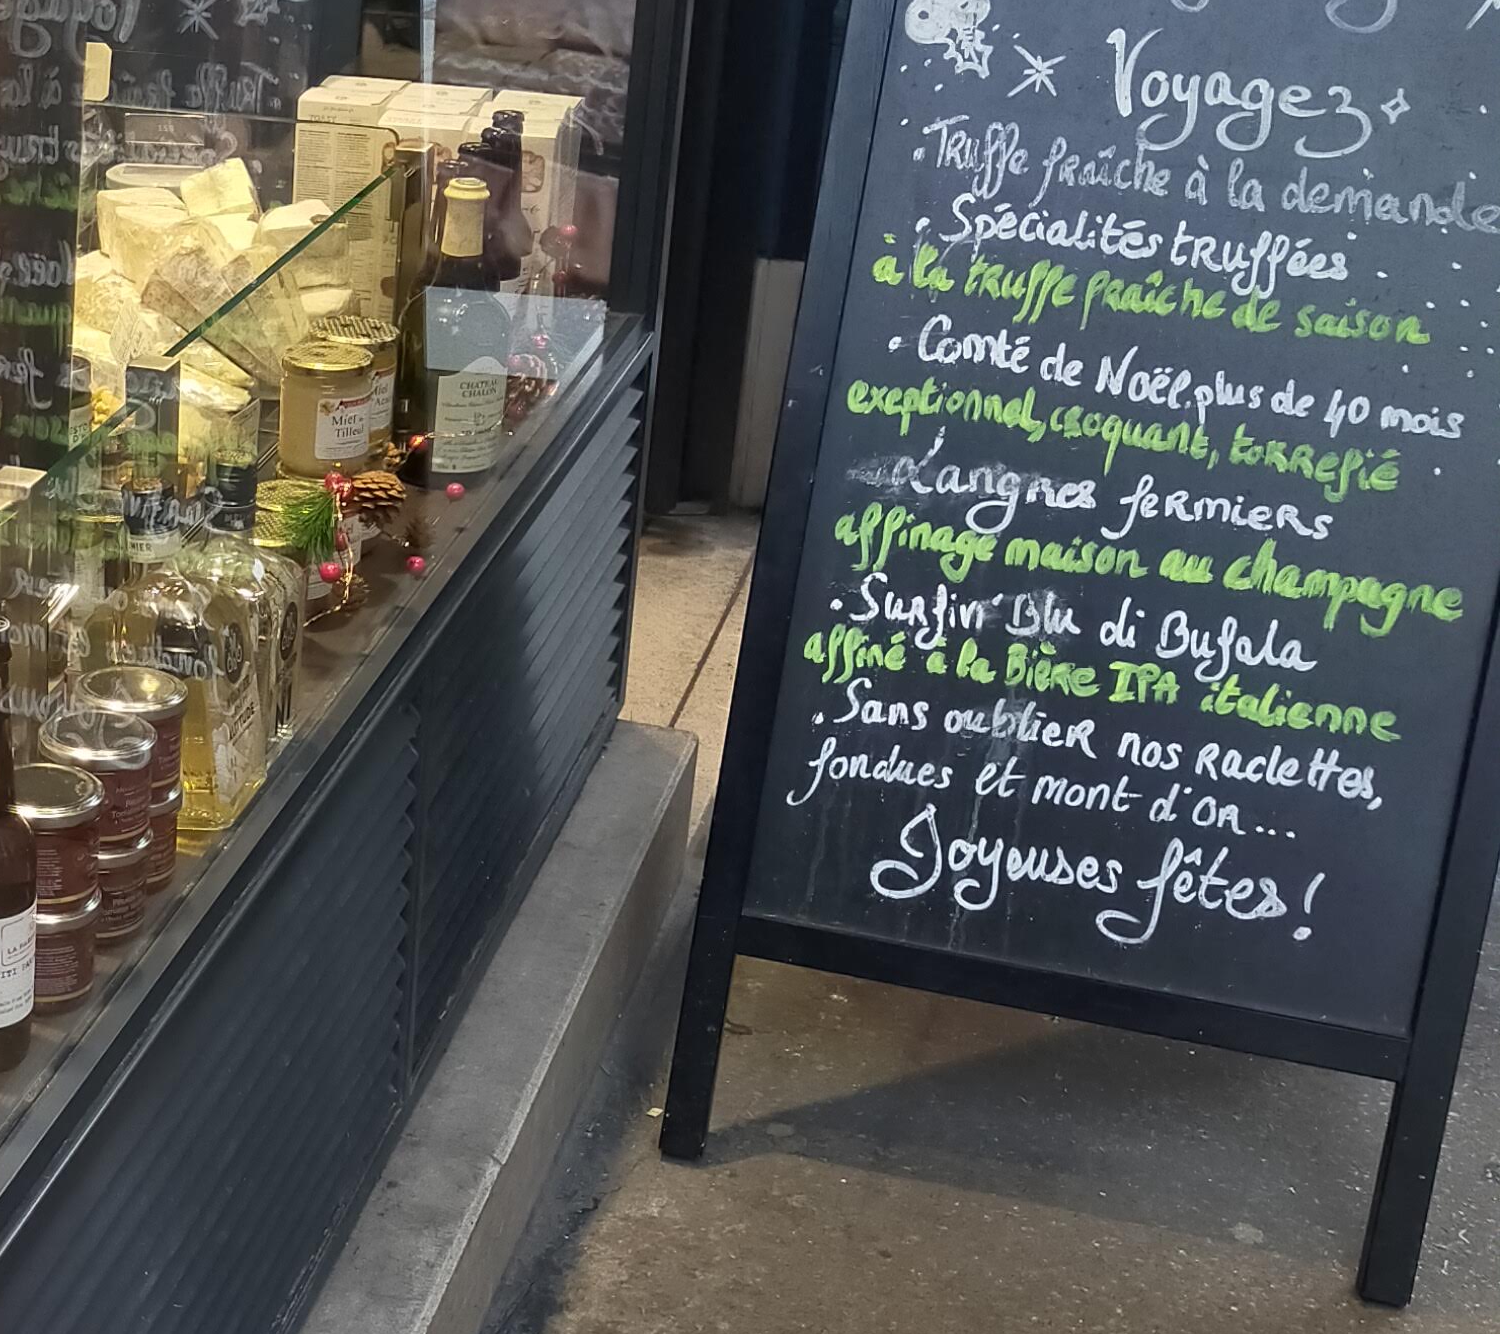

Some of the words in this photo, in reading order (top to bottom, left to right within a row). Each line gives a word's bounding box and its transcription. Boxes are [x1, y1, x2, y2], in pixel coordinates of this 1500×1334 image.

[1106, 27, 1373, 158] Voyagez
[922, 114, 1029, 198] Truffe
[1184, 153, 1209, 205] à
[1227, 157, 1266, 212] la
[1280, 165, 1500, 235] demande
[871, 233, 904, 286] à
[910, 239, 957, 294] la
[963, 251, 1073, 325] truffe
[1080, 269, 1227, 330] fraîche
[1231, 284, 1282, 333] de
[1293, 297, 1431, 345] saison
[940, 192, 1164, 262] Spécialités
[1169, 220, 1349, 300] truffées
[331, 413, 358, 426] Miel
[461, 388, 498, 399] CHALON
[916, 314, 1031, 371] Comté
[1039, 336, 1083, 388] de
[1269, 378, 1316, 420] de
[1322, 388, 1371, 440] 40
[1378, 403, 1465, 441] mois
[1100, 473, 1334, 541] fermiers
[833, 501, 998, 581] affinage
[1003, 537, 1150, 581] maison
[1158, 550, 1215, 585] au
[1221, 539, 1466, 638] champagne
[802, 628, 907, 686] affiné
[956, 643, 995, 685] la
[1004, 640, 1101, 701] Bière
[1107, 661, 1181, 706] IPA
[1199, 676, 1401, 742] italienne
[1006, 591, 1081, 638] Blu
[1099, 596, 1146, 650] di
[1154, 611, 1318, 684] Bufala
[786, 736, 954, 807] fondues
[975, 763, 1026, 801] et
[1031, 770, 1142, 821] mont
[833, 677, 930, 732] Sans
[943, 697, 1099, 759] oublier
[1116, 732, 1182, 771] nos
[869, 802, 1123, 913] Joyeuses
